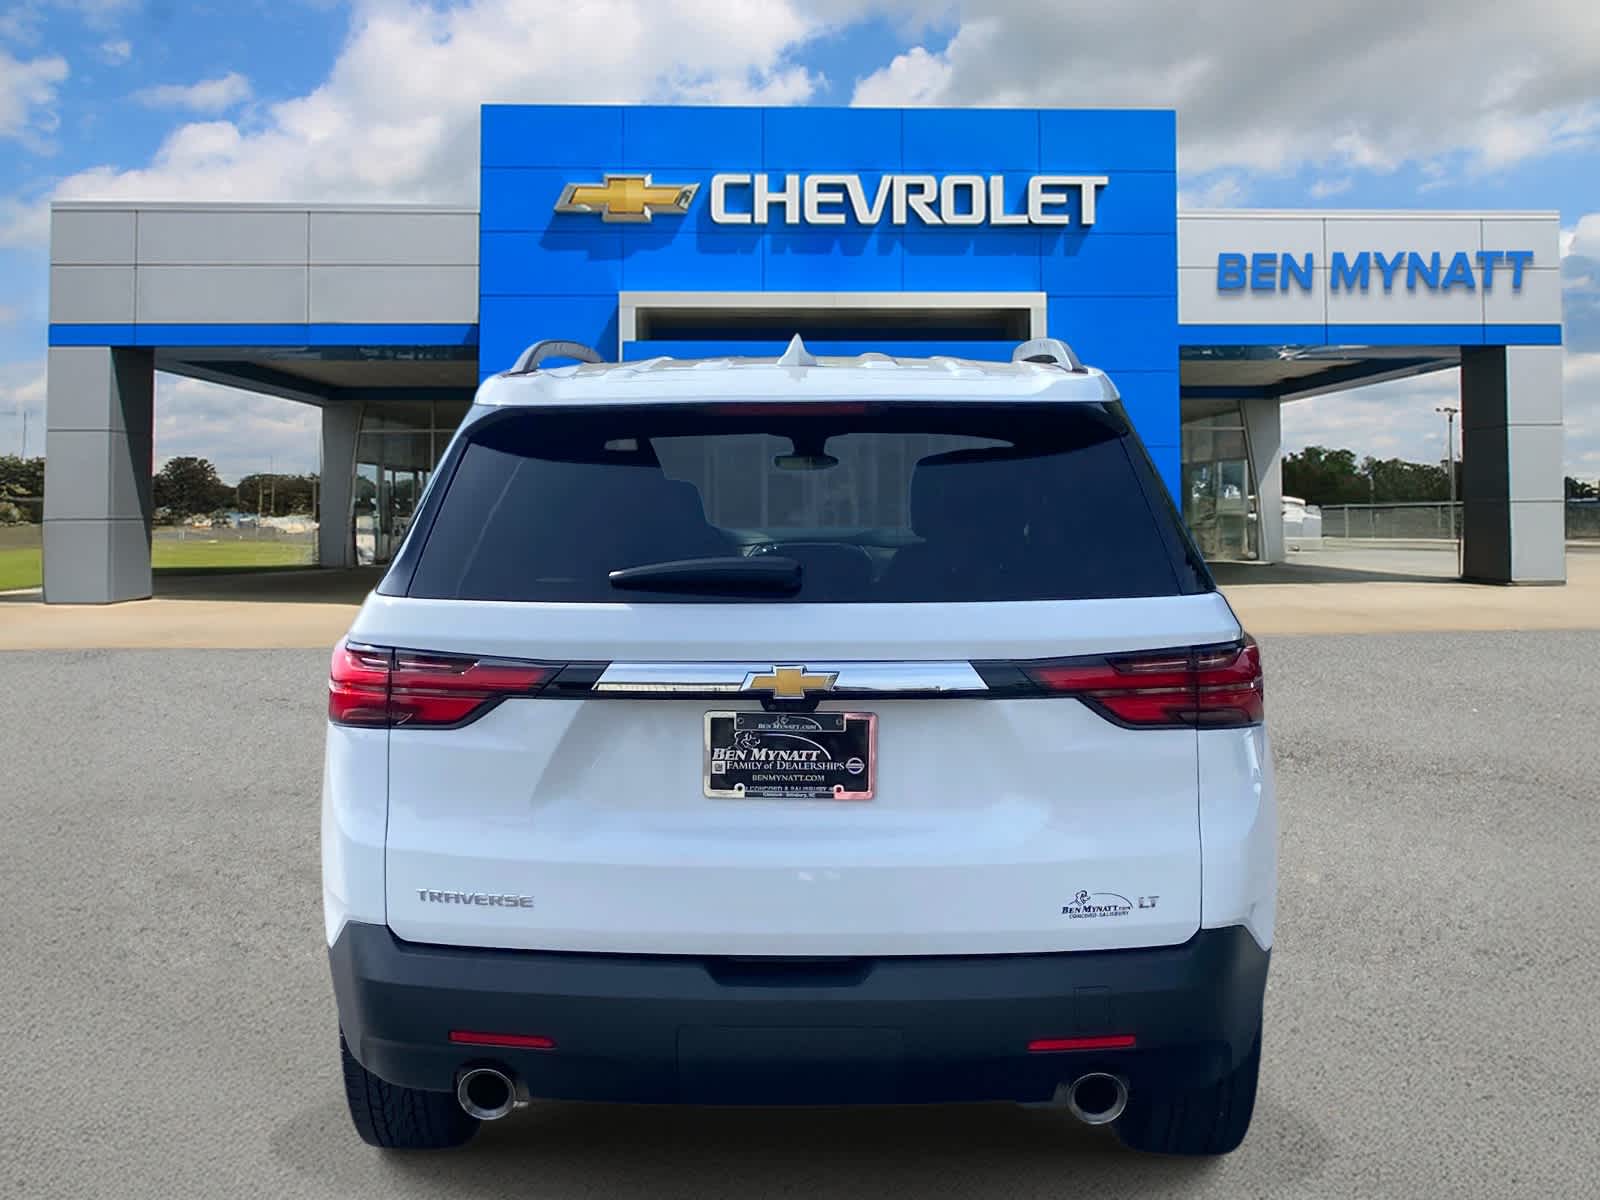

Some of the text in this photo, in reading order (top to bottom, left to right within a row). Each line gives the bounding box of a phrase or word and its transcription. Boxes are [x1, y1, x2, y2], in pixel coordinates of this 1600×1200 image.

[711, 173, 1109, 225] CHEVROLET
[1217, 250, 1534, 290] BEN MYNATT
[712, 748, 820, 761] BEN MYNATT
[726, 760, 762, 770] FAMILY
[763, 760, 773, 770] of
[776, 760, 845, 770] DEALERSHIPS
[752, 774, 825, 782] BENMYNATT.COM
[416, 888, 535, 908] TRAVERSE
[1138, 896, 1160, 909] LT
[1062, 906, 1081, 914] BEN
